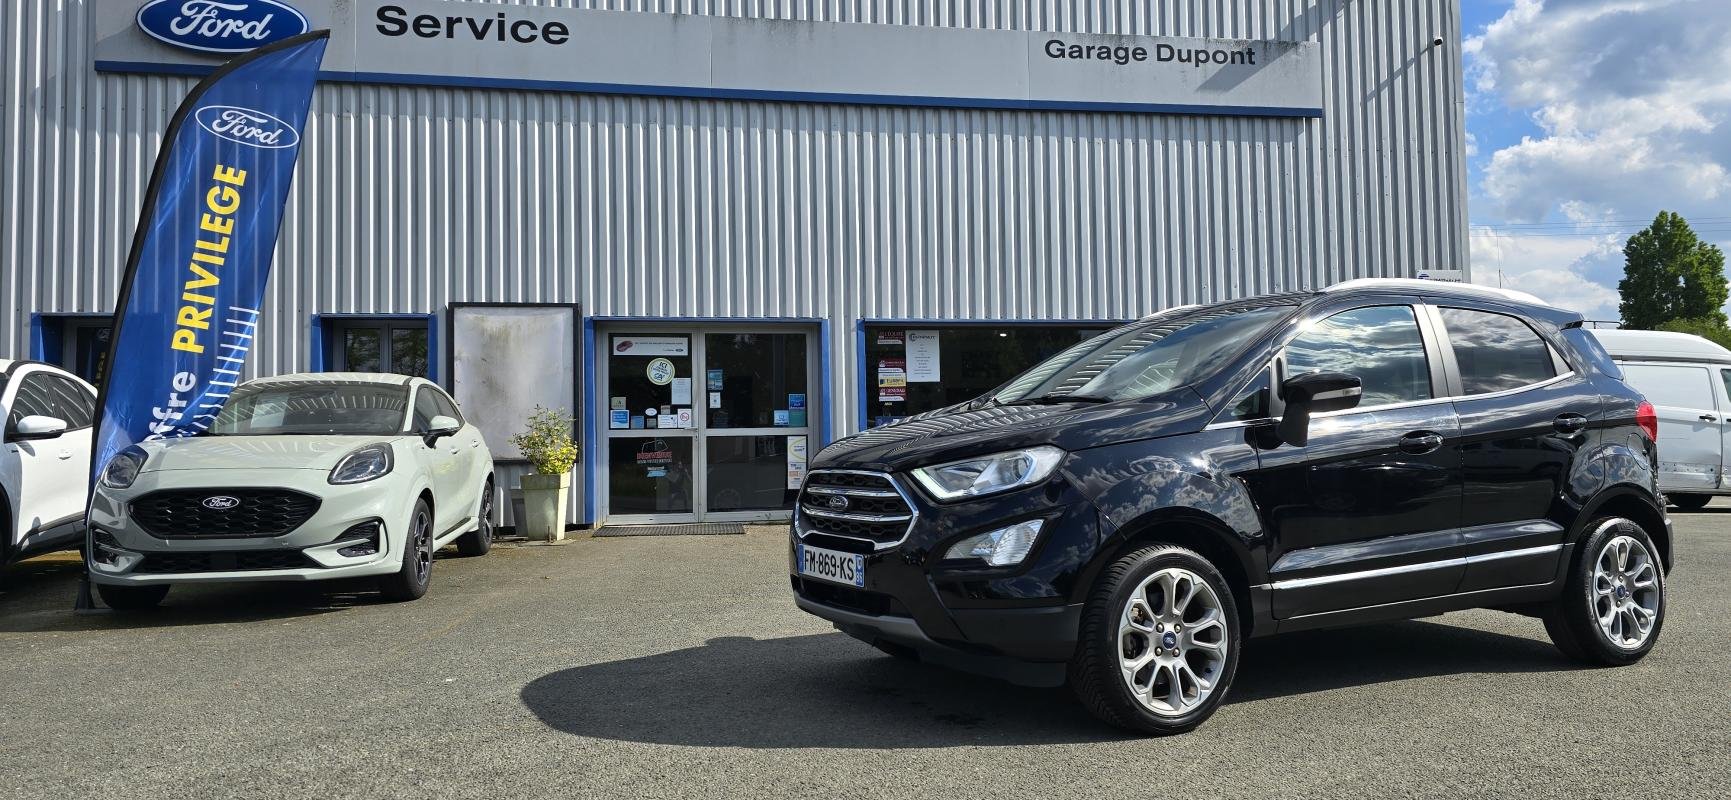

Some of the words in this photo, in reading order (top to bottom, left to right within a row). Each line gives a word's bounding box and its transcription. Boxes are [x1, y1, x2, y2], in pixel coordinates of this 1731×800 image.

[169, 0, 275, 41] Ford
[376, 5, 570, 45] Service
[1044, 39, 1148, 65] Garage
[1156, 43, 1256, 67] Dupont
[211, 109, 285, 146] Ford
[144, 371, 197, 442] ffre
[171, 164, 247, 354] PRIVILEGE
[804, 549, 855, 581] FM-869-KS
